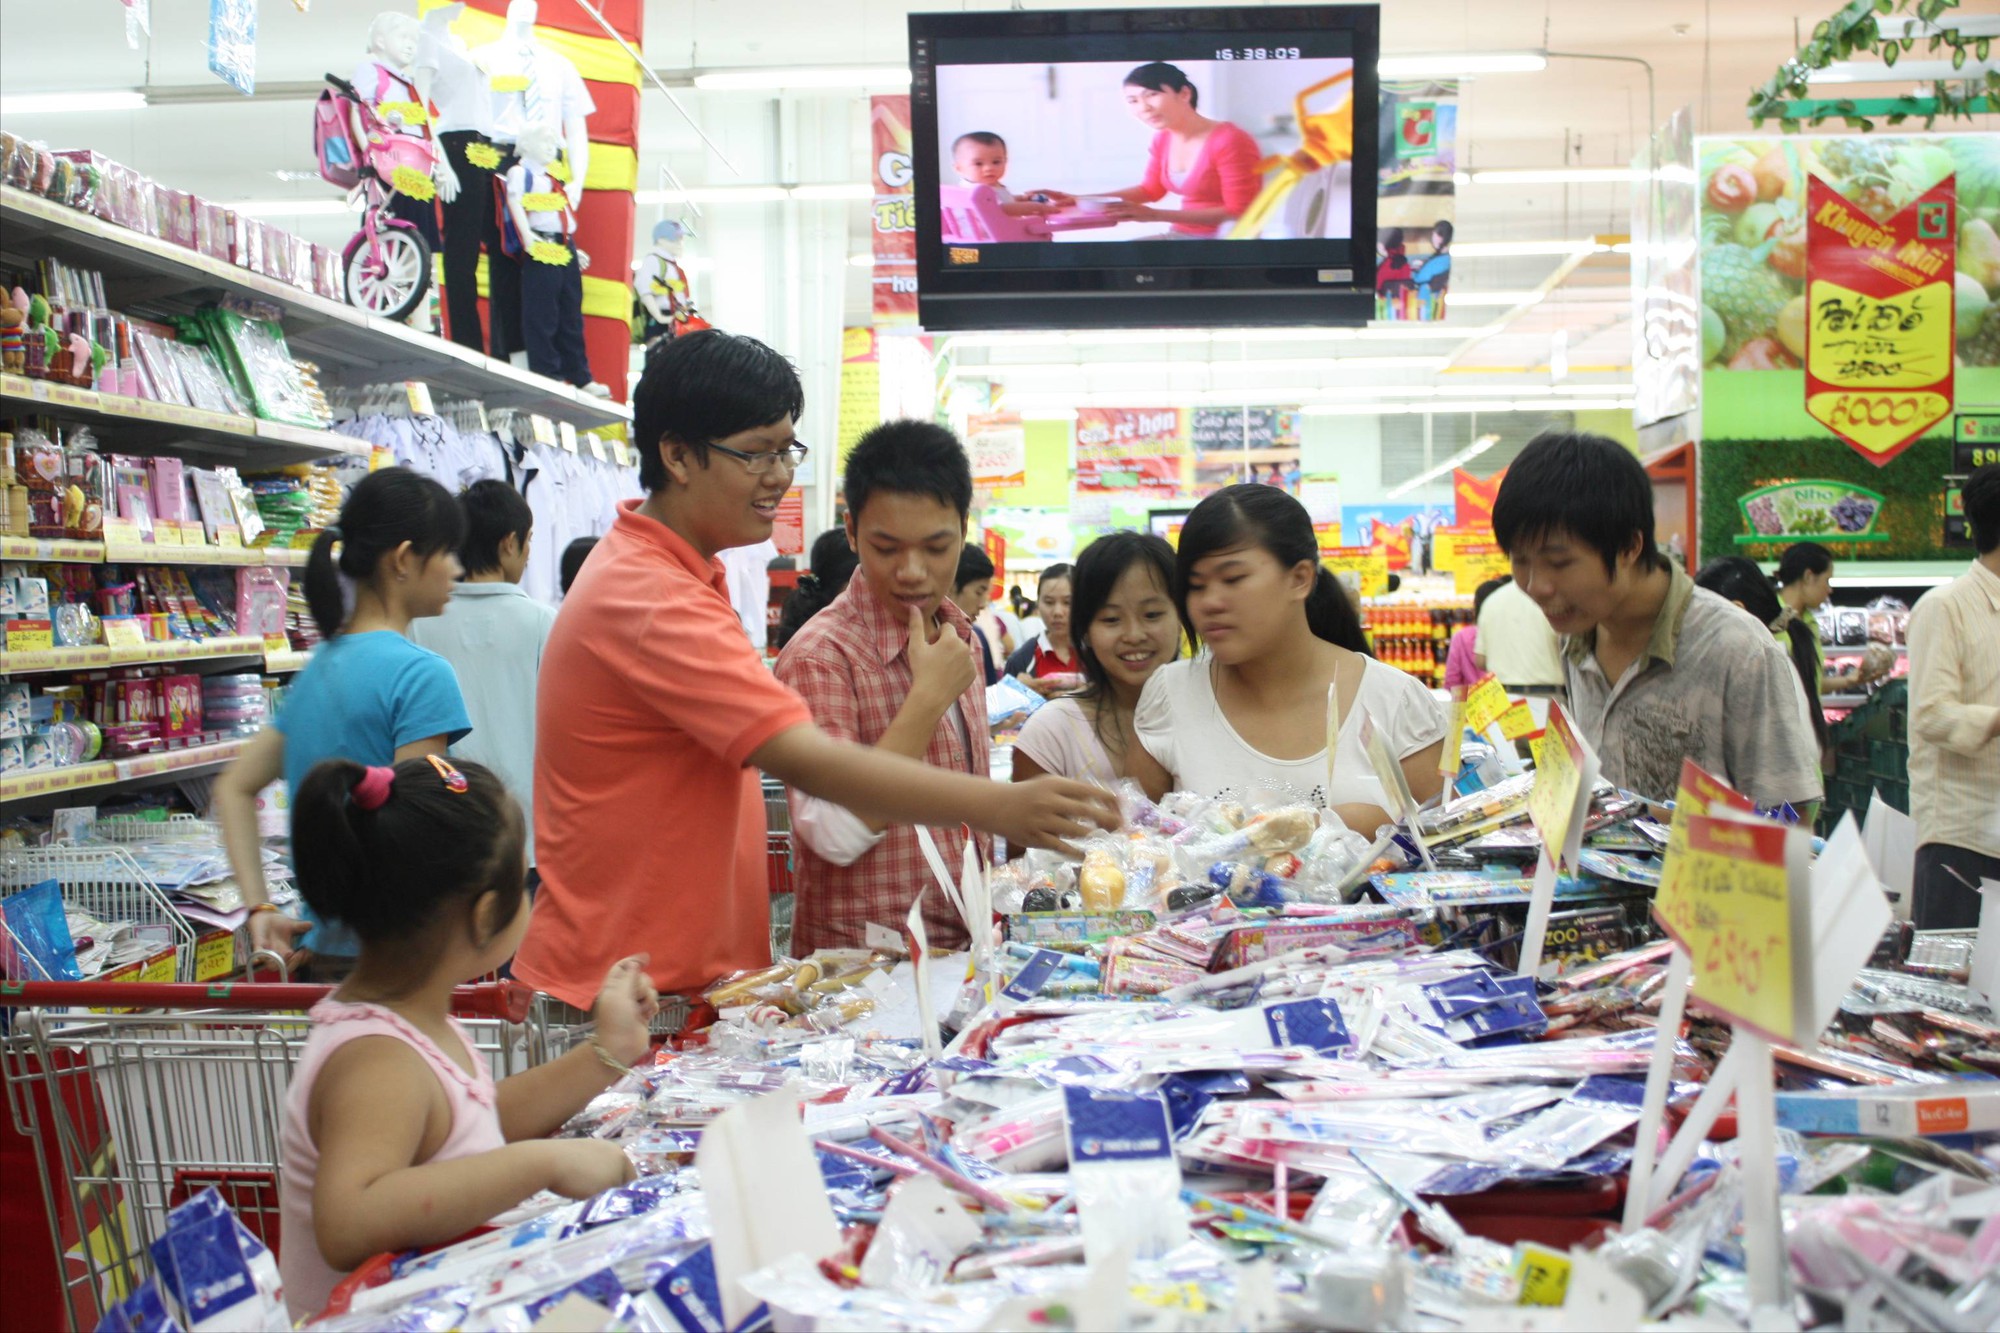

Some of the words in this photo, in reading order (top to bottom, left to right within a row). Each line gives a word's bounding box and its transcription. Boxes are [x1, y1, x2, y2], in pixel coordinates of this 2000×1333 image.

[1215, 47, 1300, 60] 16:38:09
[1972, 448, 2000, 467] 89
[1545, 928, 1579, 946] ZOO
